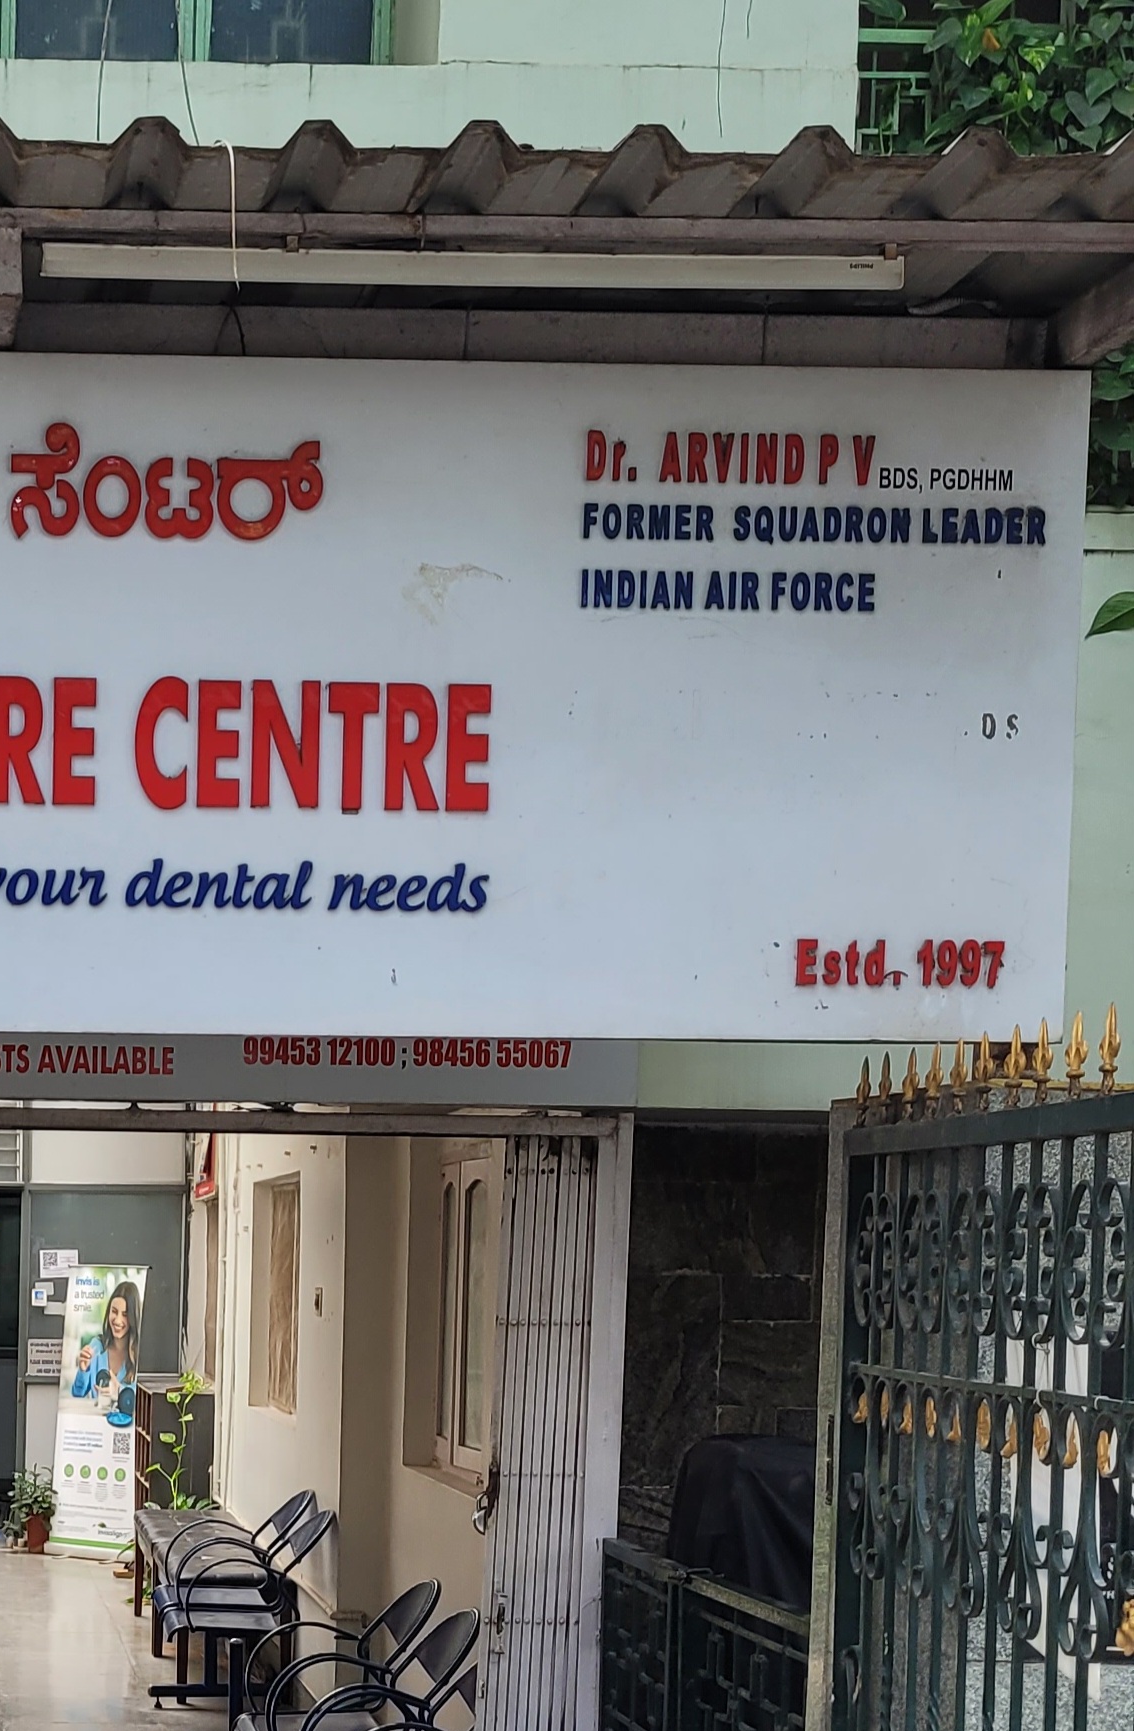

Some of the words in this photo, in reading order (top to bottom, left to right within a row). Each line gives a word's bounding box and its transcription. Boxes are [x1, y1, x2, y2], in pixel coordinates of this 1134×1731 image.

[10, 422, 324, 540] ಸೆಂಟರ್
[586, 430, 637, 482] Dr.
[659, 431, 805, 485] ARVIND
[818, 434, 839, 485] P
[853, 435, 876, 486] V
[878, 466, 923, 495] BDS,
[929, 467, 1014, 492] PGDHHM
[582, 502, 715, 542] FORMER
[732, 504, 912, 546] SQUADRON
[921, 505, 1047, 547] LEADER
[580, 568, 694, 611] INDIAN
[703, 570, 760, 612] AIR
[770, 571, 876, 613] FORCE
[134, 675, 492, 814] CENTRE
[124, 858, 314, 911] dental
[327, 862, 490, 913] needs
[796, 938, 902, 988] Estd.
[917, 938, 1006, 989] 1997
[37, 1045, 175, 1075] AVAILABLE
[243, 1036, 321, 1066] 99453
[326, 1037, 396, 1067] 12100
[412, 1038, 491, 1068] 98456
[496, 1039, 572, 1069] 55067
